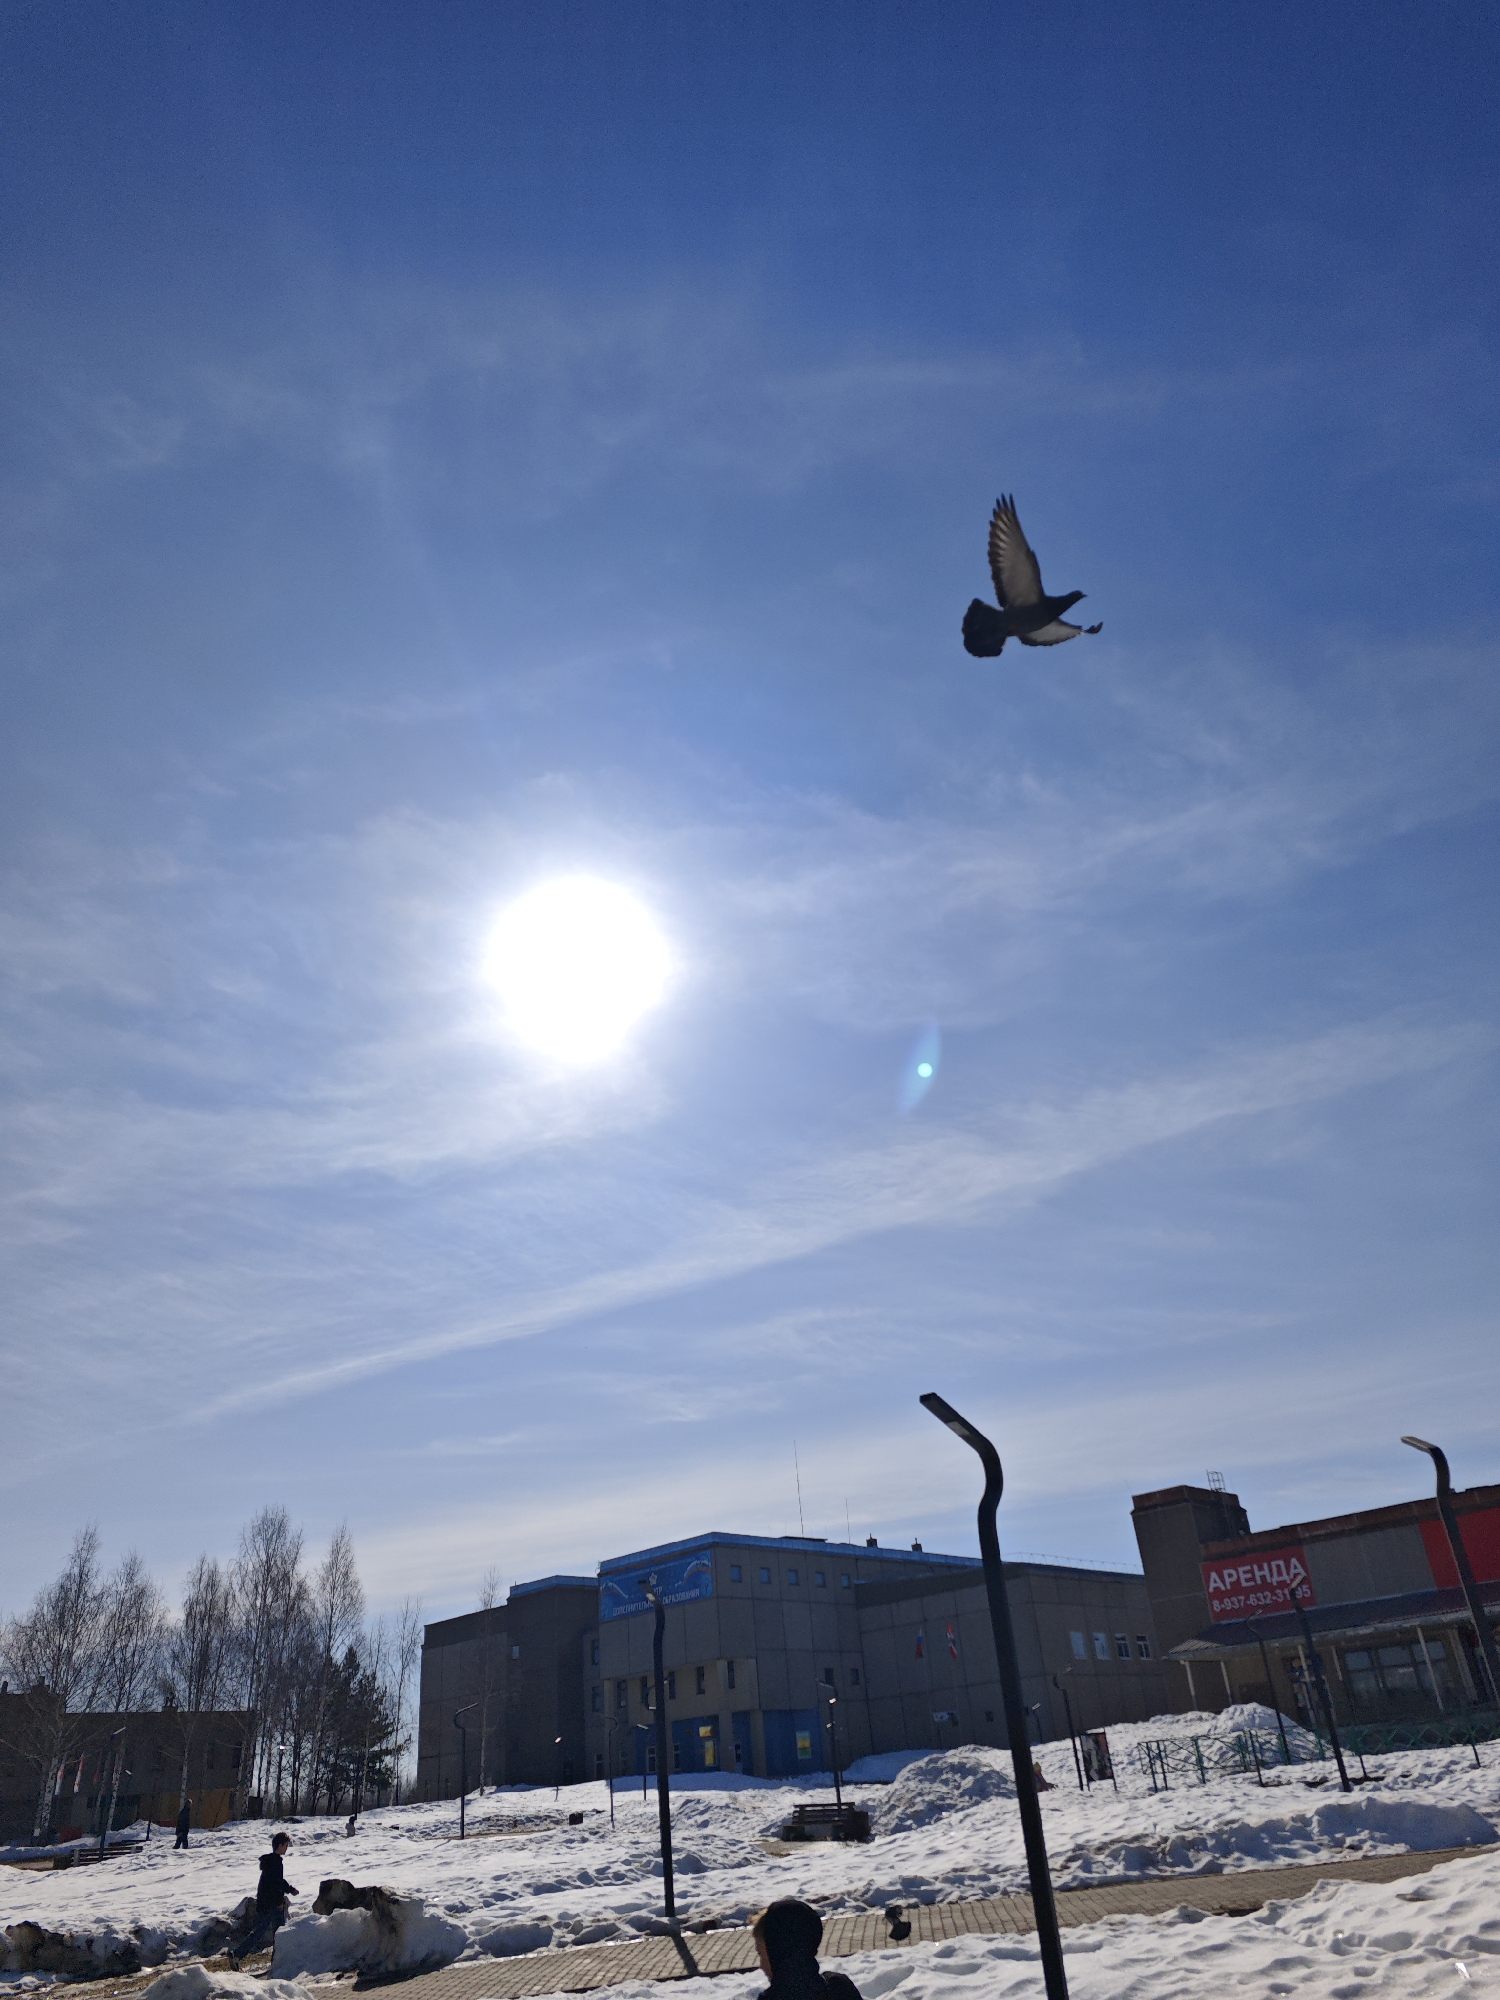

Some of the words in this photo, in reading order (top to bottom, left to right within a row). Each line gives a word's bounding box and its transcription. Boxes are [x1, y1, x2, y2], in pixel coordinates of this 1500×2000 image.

[1208, 1557, 1306, 1593] АРЕНДА
[662, 1588, 700, 1605] ОБРАЗОВАНИЯ
[1212, 1585, 1312, 1612] 8-937-632-3195
